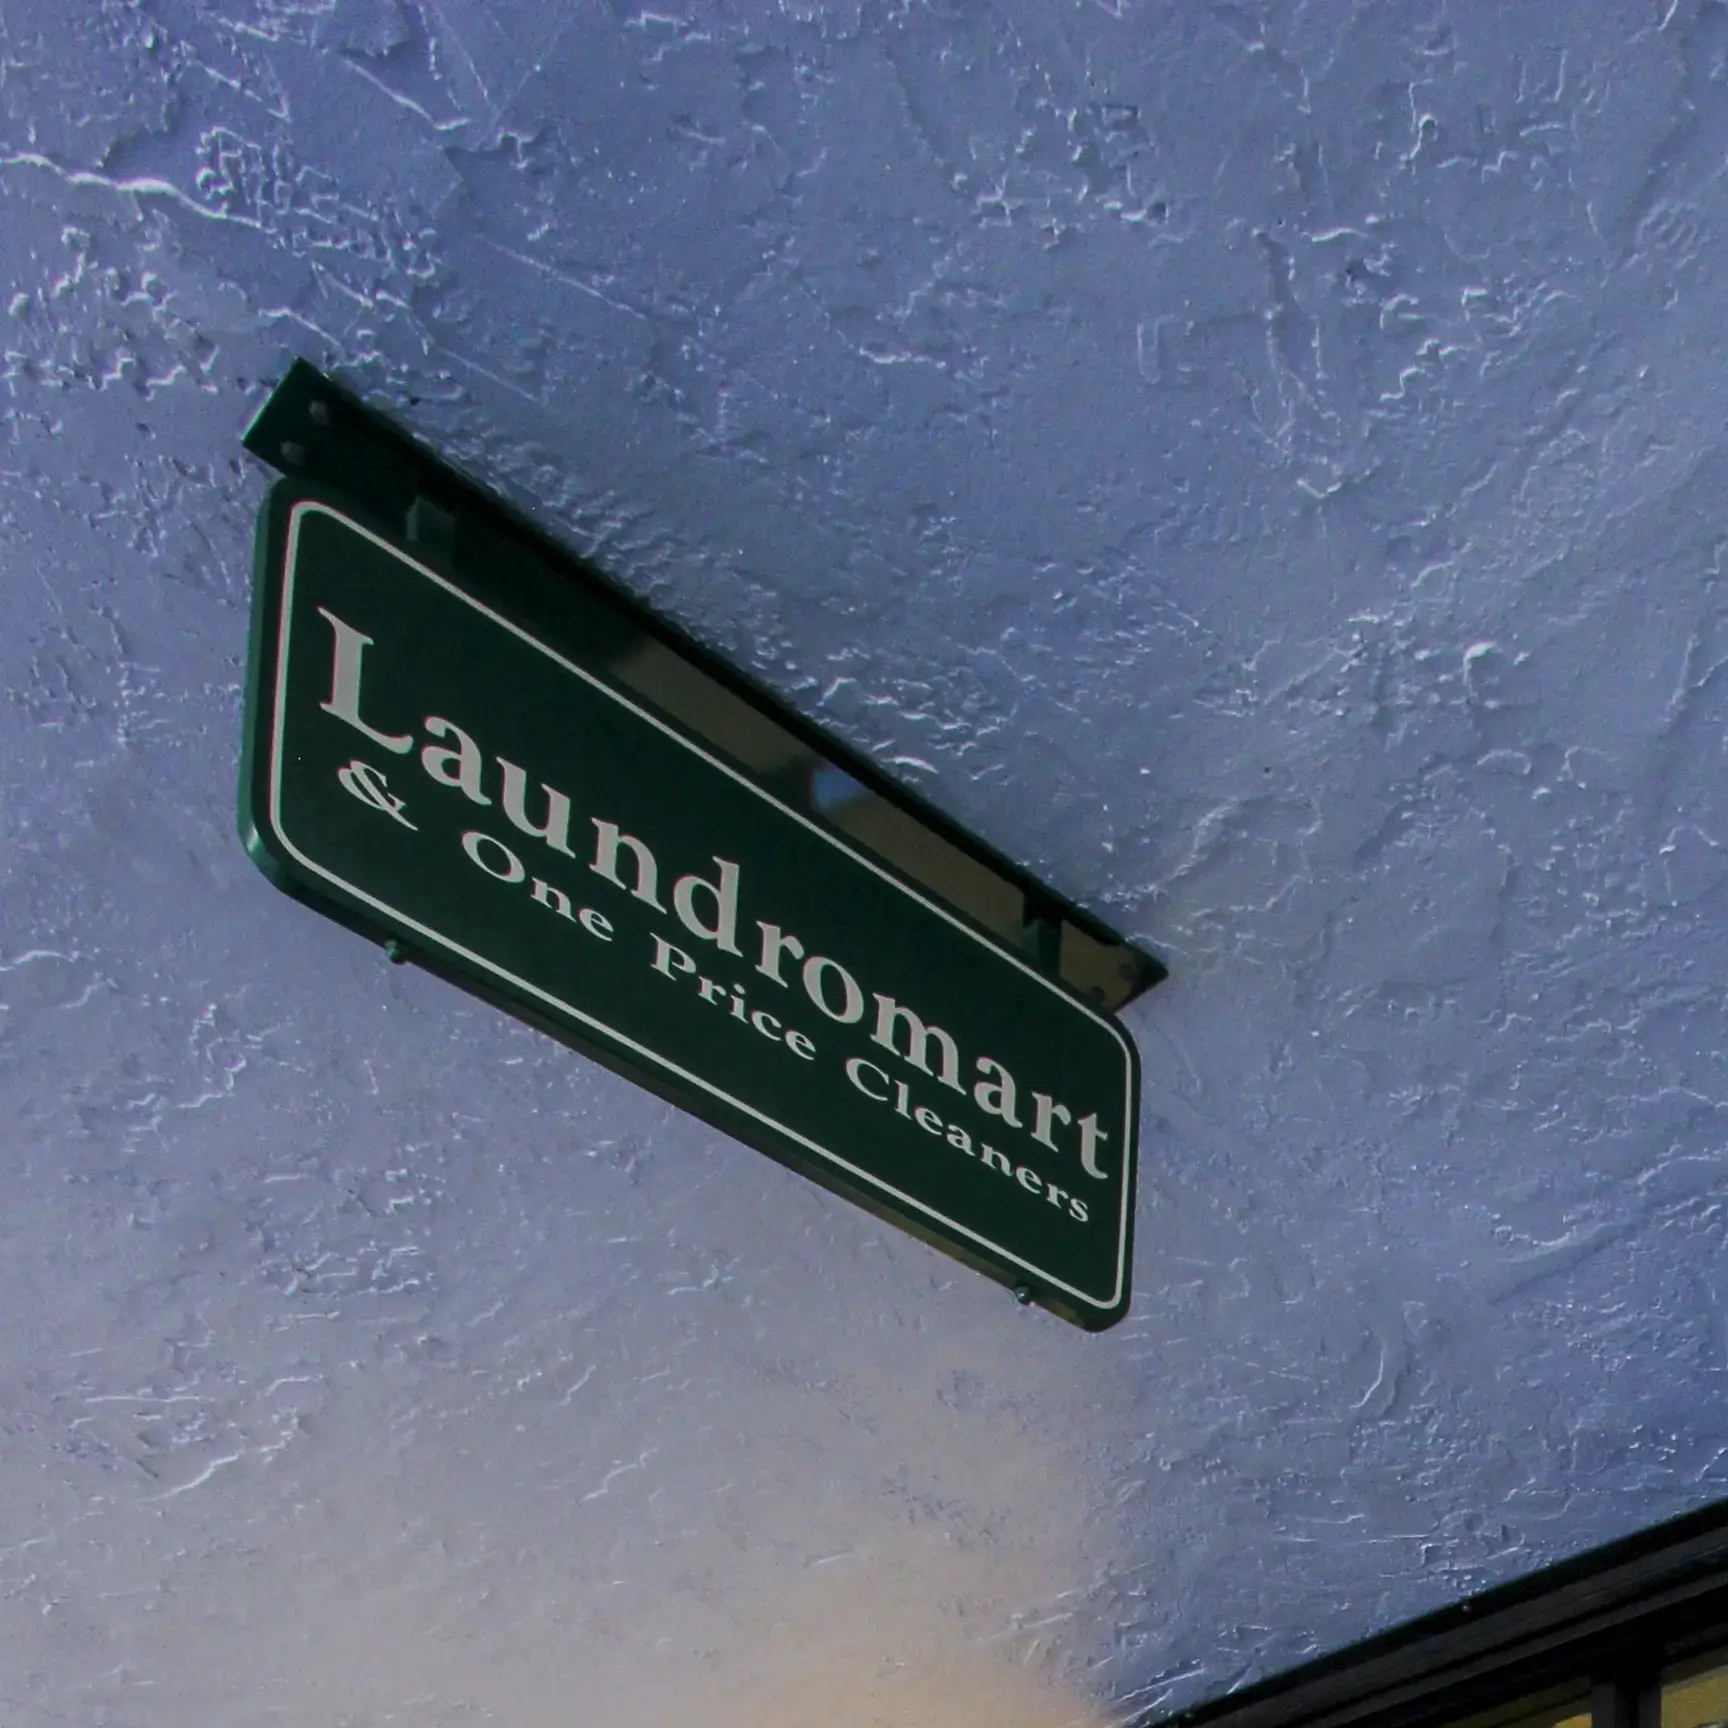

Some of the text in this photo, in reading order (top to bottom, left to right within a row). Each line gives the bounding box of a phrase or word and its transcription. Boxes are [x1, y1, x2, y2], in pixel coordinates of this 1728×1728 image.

[317, 607, 1109, 1180] Laundromart
[337, 760, 1090, 1223] & One Price Cleaners
